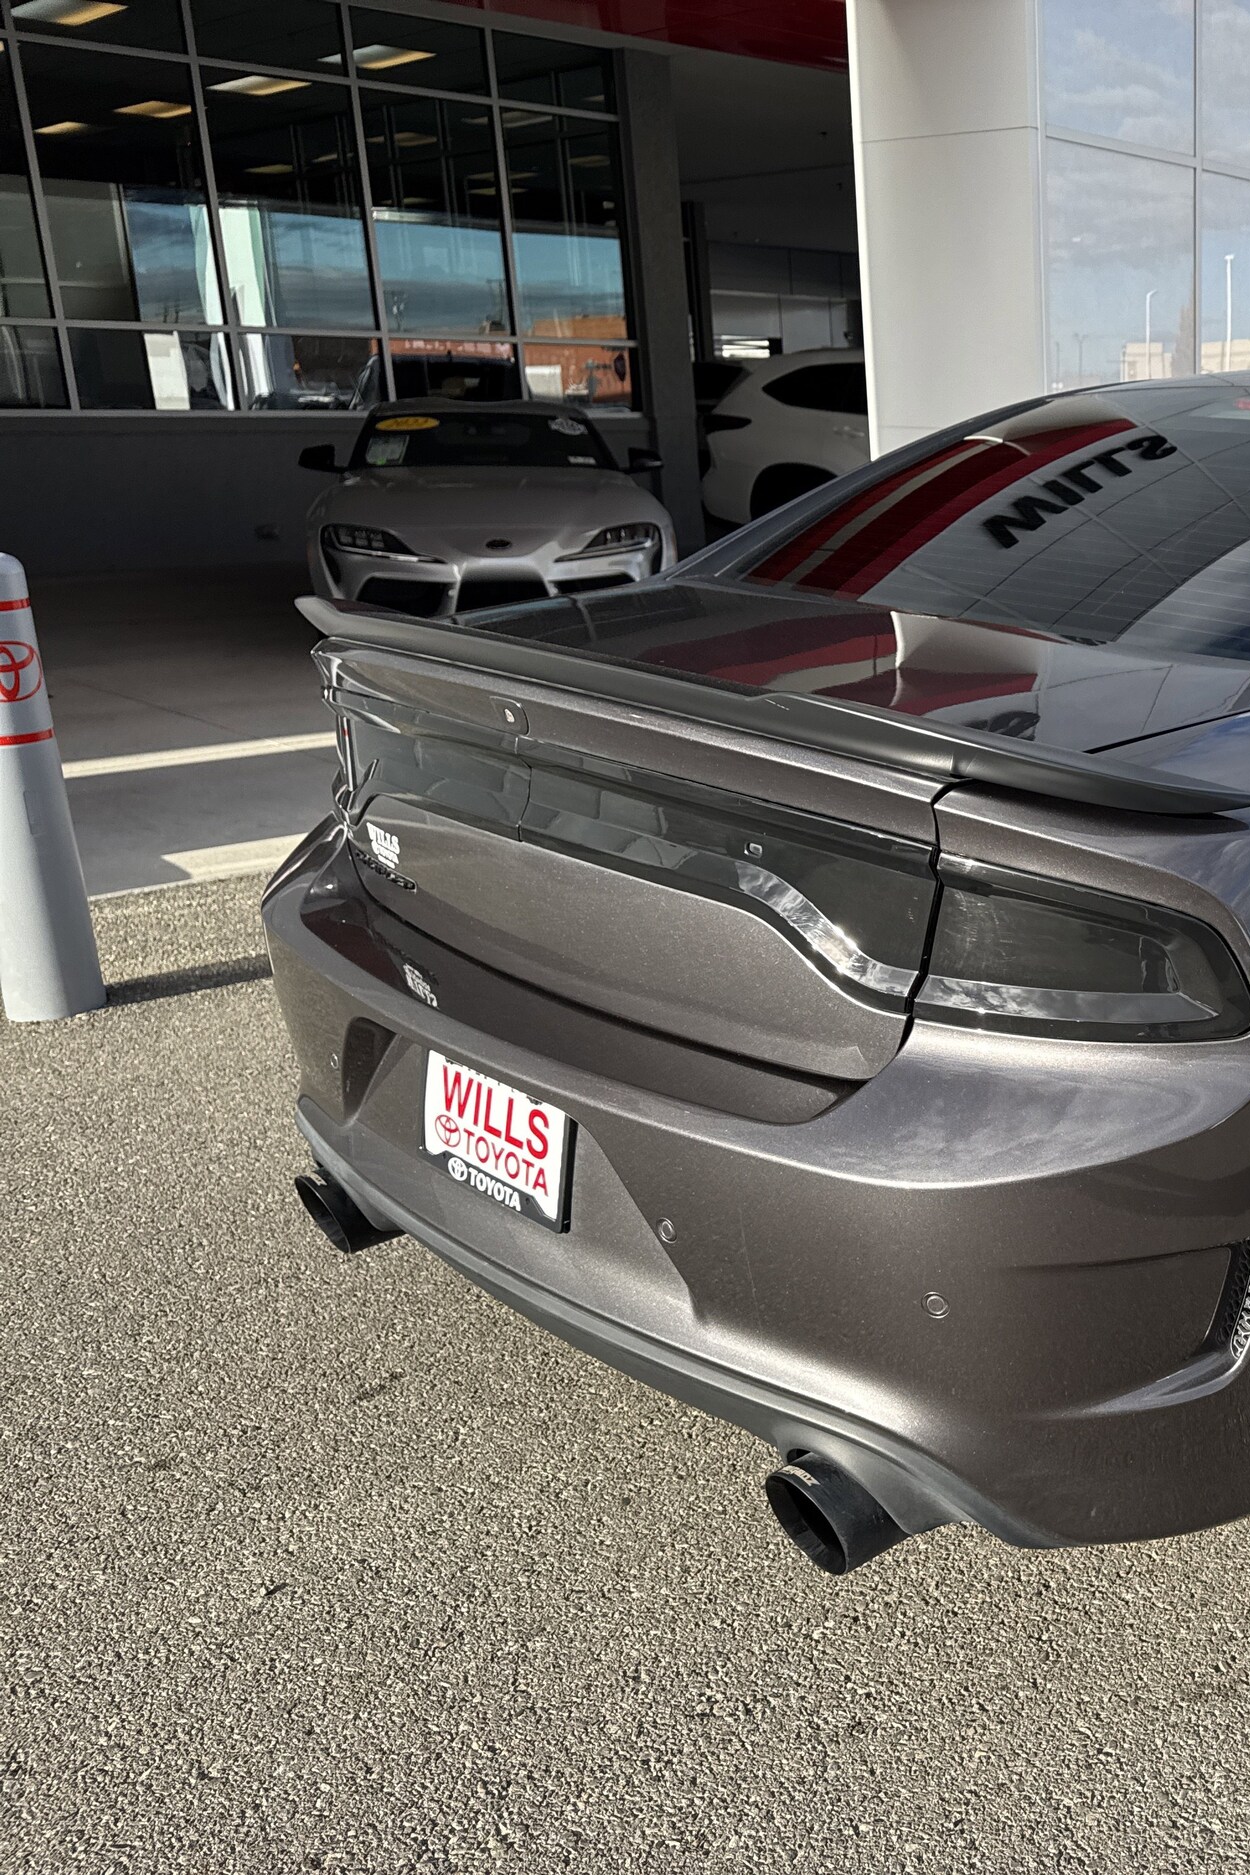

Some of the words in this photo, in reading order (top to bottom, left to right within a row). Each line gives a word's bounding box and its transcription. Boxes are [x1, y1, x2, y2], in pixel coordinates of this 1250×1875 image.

[366, 822, 400, 854] WILLS
[443, 1064, 549, 1160] WILLS
[464, 1128, 549, 1197] TOYOTA
[469, 1167, 522, 1211] TOYOTA
